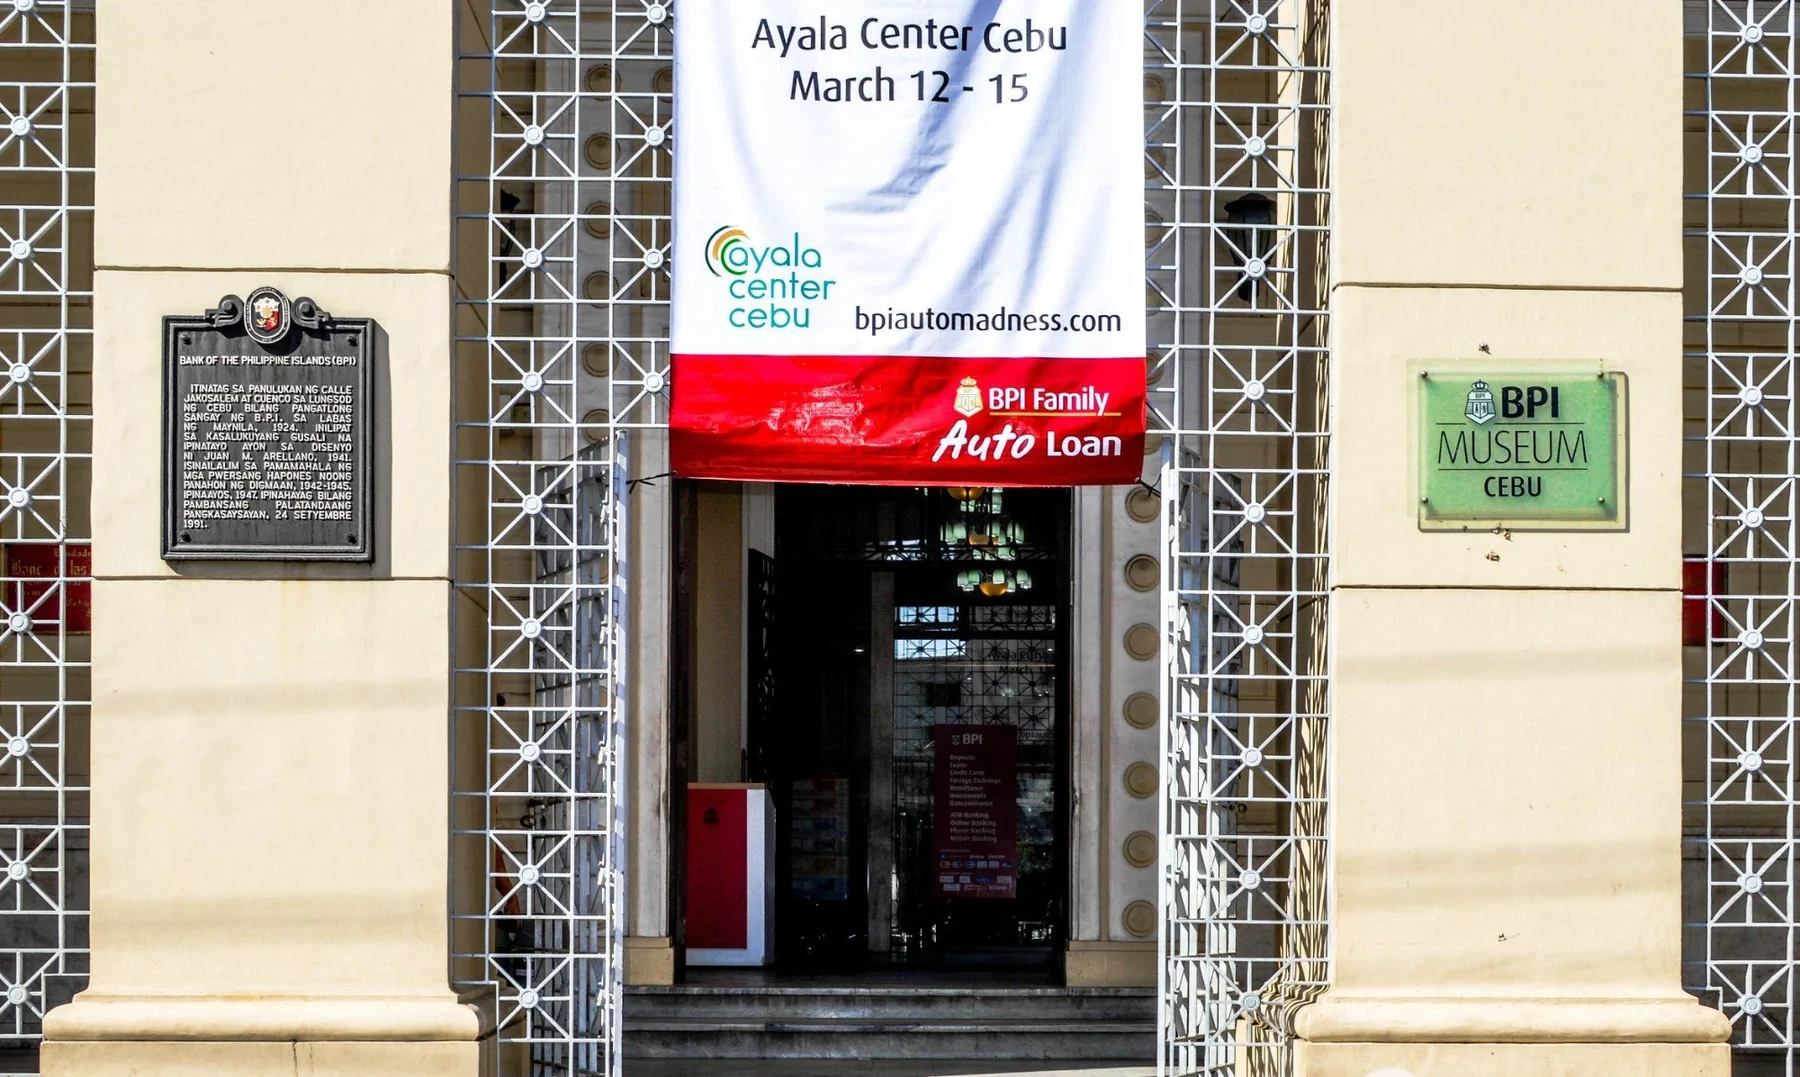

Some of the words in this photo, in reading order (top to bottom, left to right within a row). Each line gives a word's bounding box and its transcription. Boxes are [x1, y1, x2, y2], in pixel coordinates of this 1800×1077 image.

[751, 15, 847, 58] Ayala
[861, 17, 973, 50] Center
[983, 19, 1067, 53] Cebu
[790, 66, 895, 102] March
[910, 70, 950, 103] 12
[988, 73, 1029, 104] 15
[729, 232, 822, 274] ayala
[729, 271, 836, 300] center
[729, 303, 809, 328] cebu
[855, 306, 1122, 336] bpiautomadness.com
[180, 356, 204, 365] BANK
[206, 356, 219, 365] OF
[221, 356, 239, 365] THE
[241, 356, 290, 365] PHILIPPINE
[291, 356, 331, 366] ISLANDS
[332, 357, 356, 366] (BPI)
[190, 384, 229, 393] ITINATAG
[232, 384, 244, 393] SA
[249, 385, 302, 393] PANULUKAN
[306, 385, 318, 394] NG
[322, 385, 352, 394] CALLE
[184, 394, 239, 403] JAKOSALEM
[241, 394, 252, 403] AT
[254, 395, 291, 403] CUENCO
[294, 395, 306, 403] SA
[309, 395, 352, 404] LUNGSOD
[989, 387, 1026, 410] BPI
[1033, 386, 1110, 416] Family
[1501, 386, 1560, 418] BPI
[184, 404, 197, 412] NG
[206, 404, 232, 412] CEBU
[245, 404, 279, 413] BILANG
[292, 405, 352, 413] PANGATLONG
[184, 413, 221, 422] SANGAY
[231, 414, 245, 422] NG
[255, 414, 283, 422] B.P.I.
[294, 414, 307, 422] SA
[320, 414, 352, 423] LABAS
[184, 423, 197, 431] NG
[213, 423, 258, 431] MAYNILA,
[273, 423, 299, 432] 1924.
[316, 424, 351, 432] INILIPAT
[184, 432, 196, 441] SA
[206, 433, 279, 441] KASALUKUYANG
[291, 433, 325, 441] GUSALI
[338, 433, 352, 442] NA
[931, 419, 1036, 463] Auto
[1047, 431, 1122, 457] Loan
[184, 442, 227, 450] IPINATAYO
[242, 442, 266, 451] AYON
[281, 443, 294, 451] SA
[312, 443, 352, 451] DISENYO
[1437, 430, 1588, 464] MUSEUM
[184, 452, 193, 460] NI
[204, 452, 229, 461] JUAN
[242, 452, 253, 461] M.
[263, 453, 317, 461] ARELLANO,
[328, 453, 352, 461] 1941.
[184, 462, 239, 470] ISINAILALIM
[244, 462, 257, 470] SA
[264, 463, 332, 471] PAMAMAHALA
[339, 463, 352, 471] NG
[184, 471, 204, 480] MGA
[208, 472, 261, 480] PWERSANG
[267, 472, 312, 480] HAPONES
[320, 472, 352, 481] NOONG
[184, 481, 226, 489] PANAHON
[231, 481, 244, 490] NG
[250, 482, 296, 490] DIGMAAN,
[300, 482, 352, 490] 1942-1945.
[1484, 476, 1542, 497] CEBU
[184, 491, 232, 499] IPINAAYOS,
[236, 491, 258, 499] 1947.
[261, 492, 312, 500] IPINAHAYAG
[318, 492, 352, 500] BILANG
[184, 501, 249, 509] PAMBANSANG
[276, 501, 352, 510] PALATANDAANG
[184, 510, 269, 519] PANGKASAYSAYAN,
[275, 511, 287, 519] 24
[294, 511, 352, 519] SETYEMBRE
[184, 520, 208, 528] 1991.
[962, 733, 983, 745] BPI
